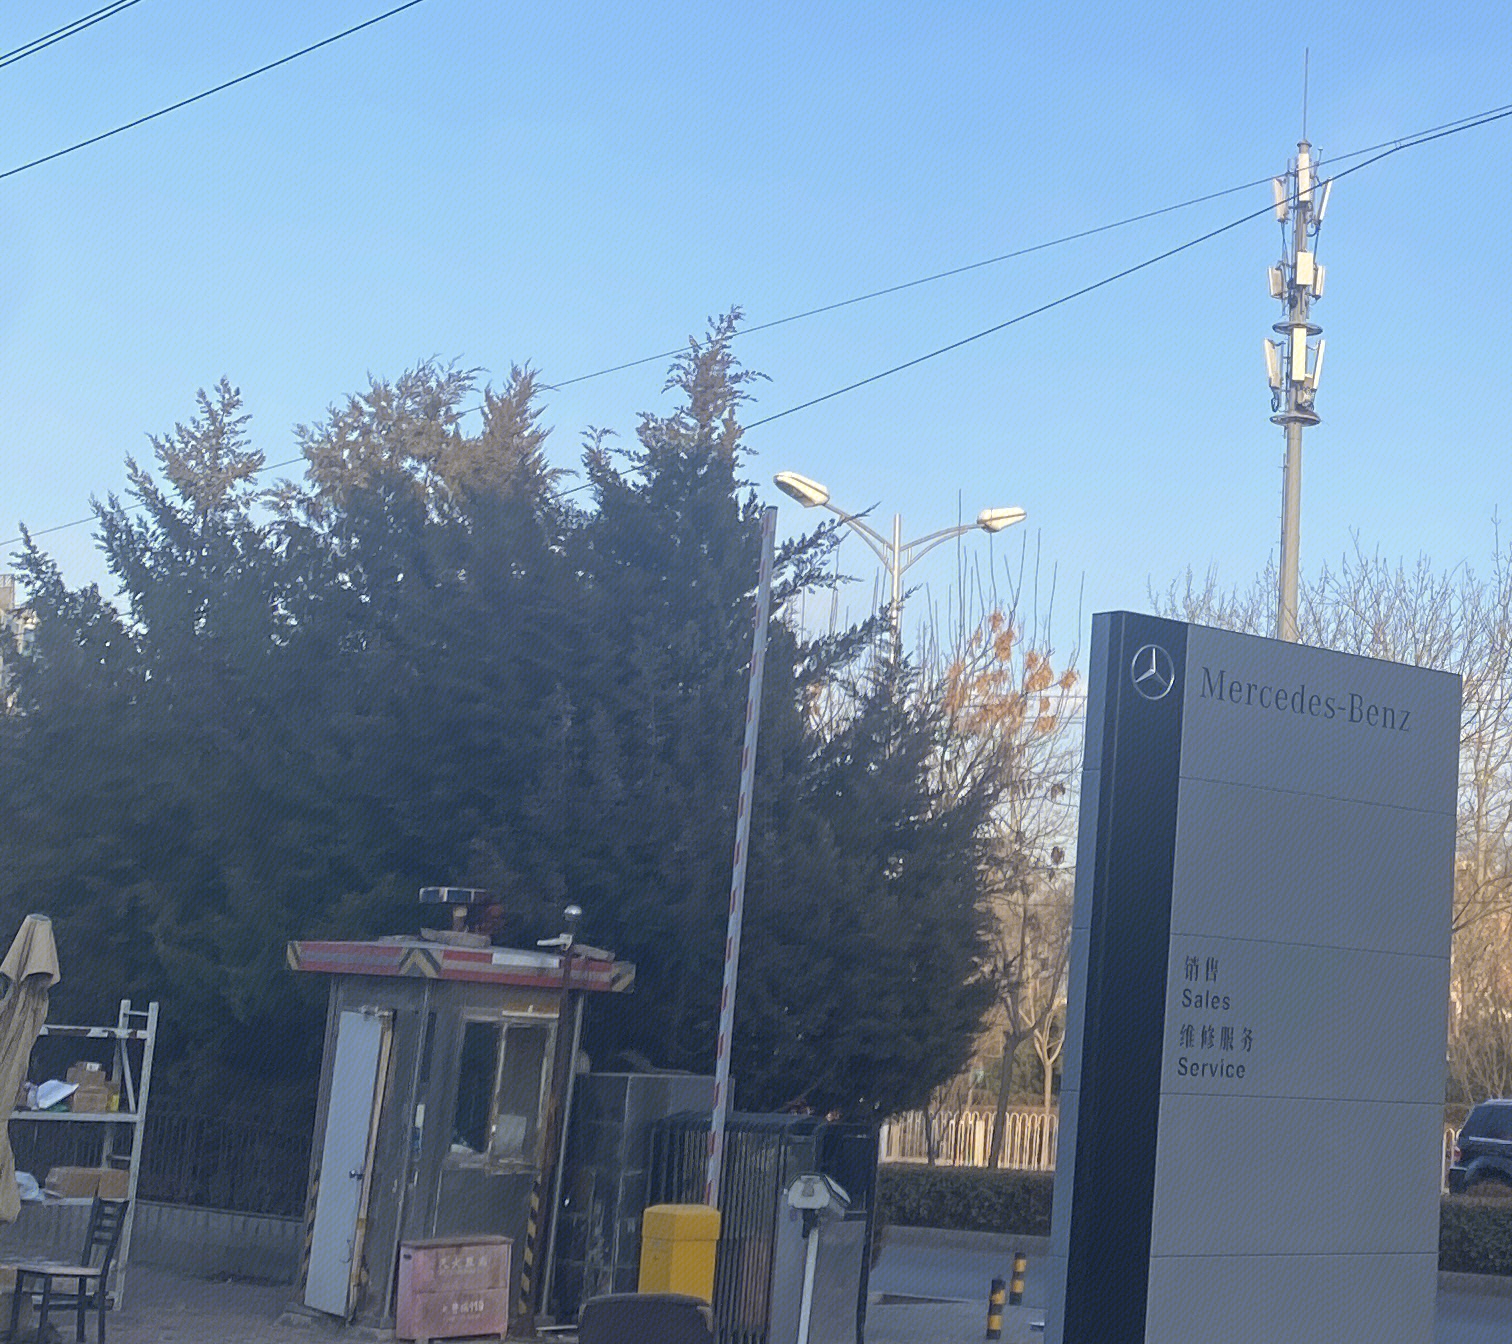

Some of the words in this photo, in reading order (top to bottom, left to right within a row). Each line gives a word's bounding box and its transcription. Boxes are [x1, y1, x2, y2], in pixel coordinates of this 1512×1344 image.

[1200, 666, 1411, 732] Mercedes-Benz
[1185, 955, 1219, 983] 销售
[1181, 988, 1231, 1011] Sales
[1179, 1023, 1254, 1053] 维修服务
[1177, 1056, 1246, 1079] Service
